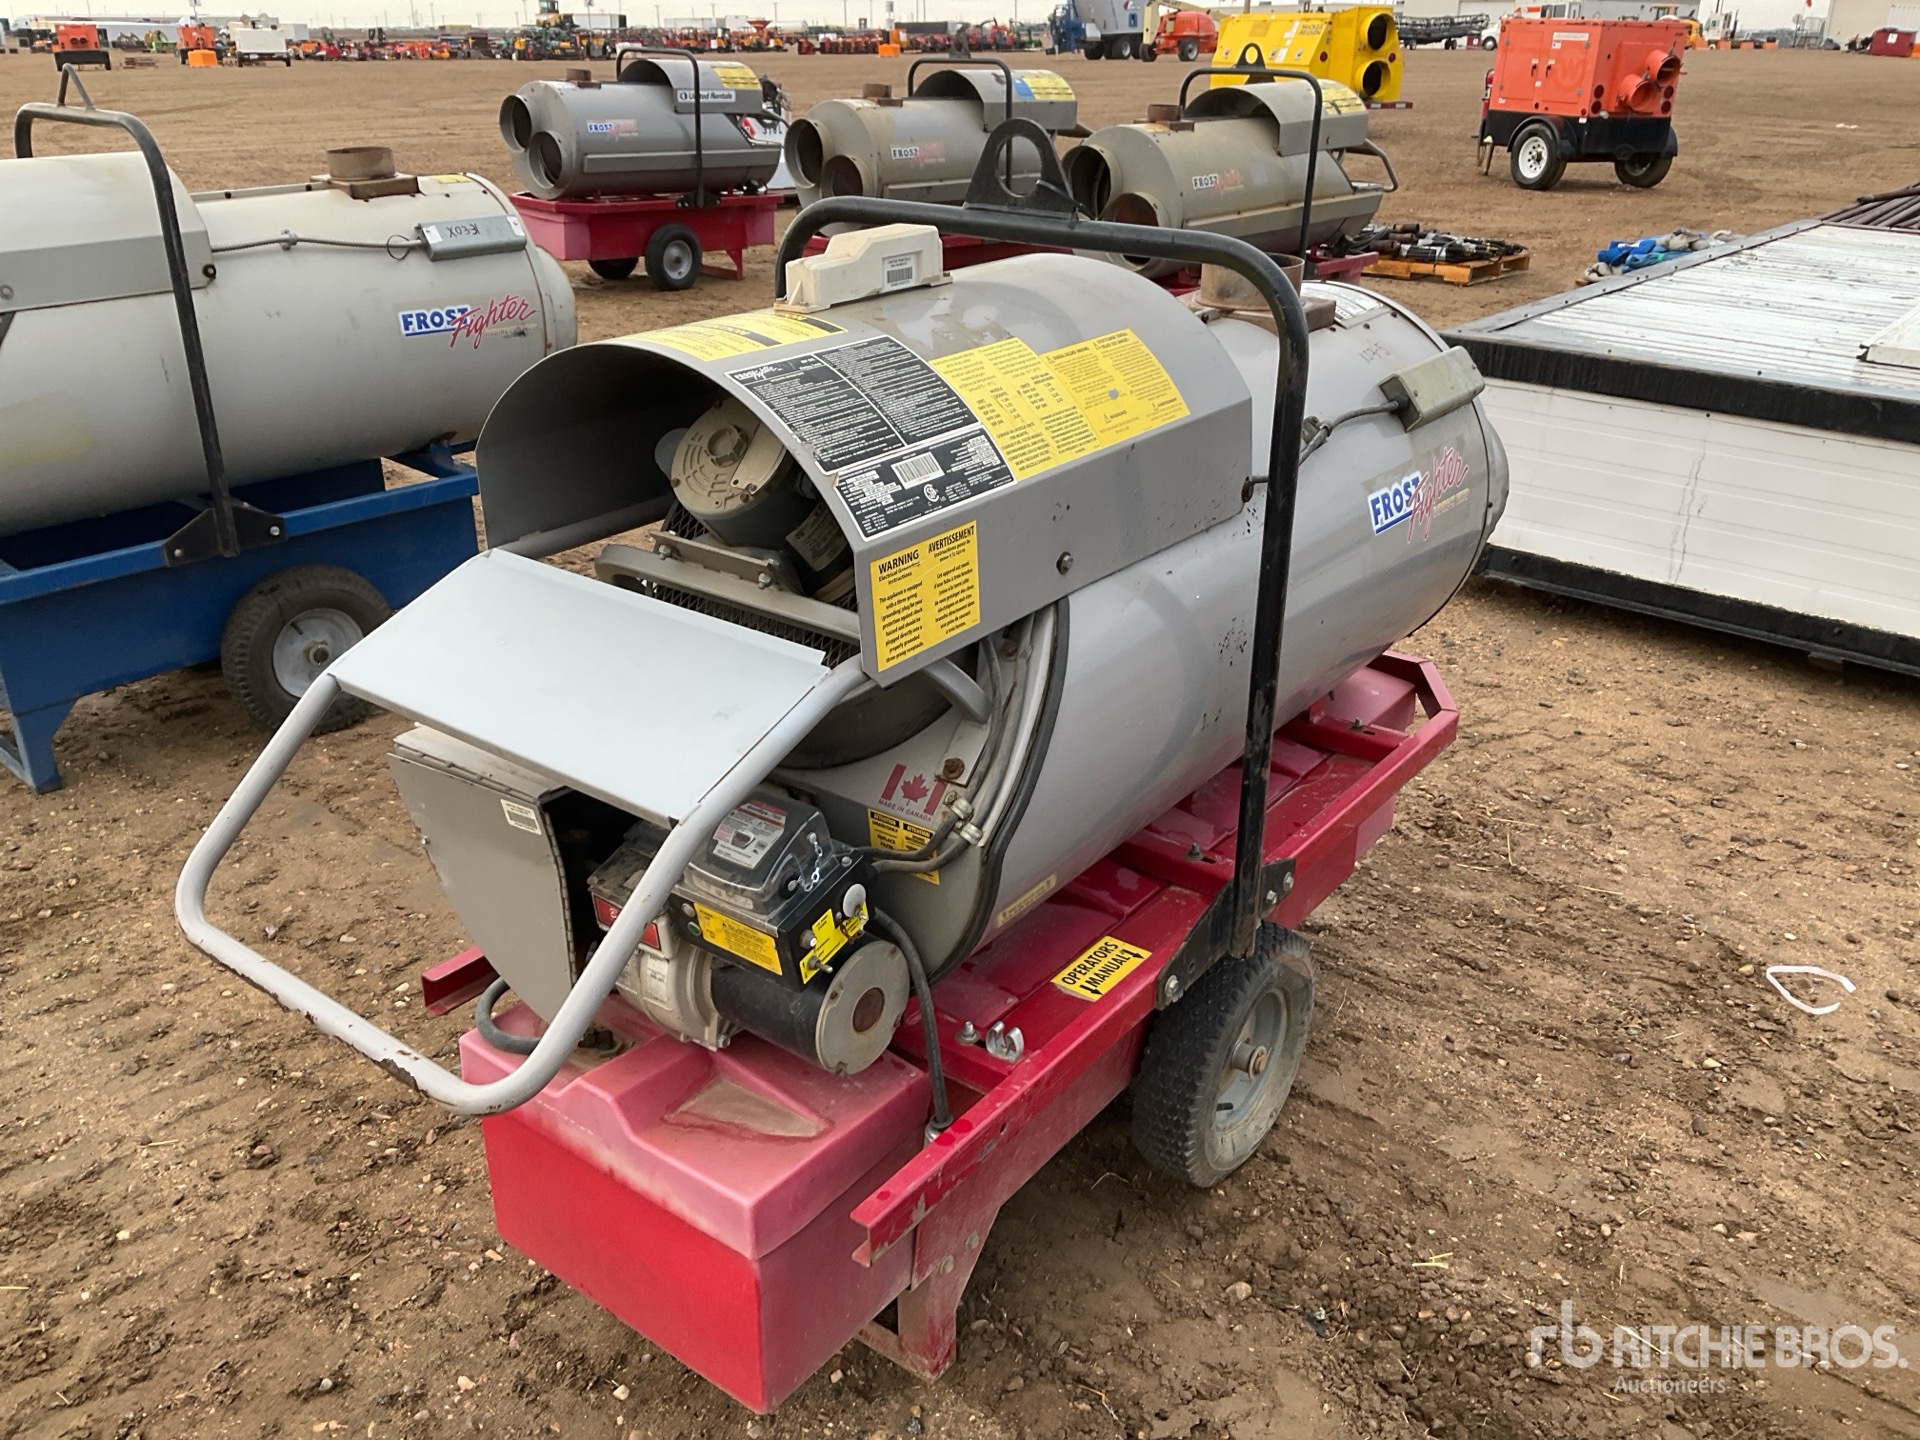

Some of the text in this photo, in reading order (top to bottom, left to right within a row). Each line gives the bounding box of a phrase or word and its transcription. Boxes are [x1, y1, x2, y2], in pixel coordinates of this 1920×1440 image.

[589, 124, 612, 132] FROST
[892, 148, 918, 158] FROST
[1193, 176, 1218, 188] FROST
[401, 294, 536, 350] FROST Fighter
[1370, 476, 1422, 526] FROST
[1407, 446, 1469, 544] Fighter
[928, 526, 974, 553] AVERTISSEMENT
[878, 549, 919, 574] WARNING
[879, 570, 897, 582] Electrical
[878, 800, 896, 810] MADE
[906, 808, 932, 822] CANADA
[1061, 942, 1118, 985] OPERATORS
[1085, 954, 1131, 988] MANUAL
